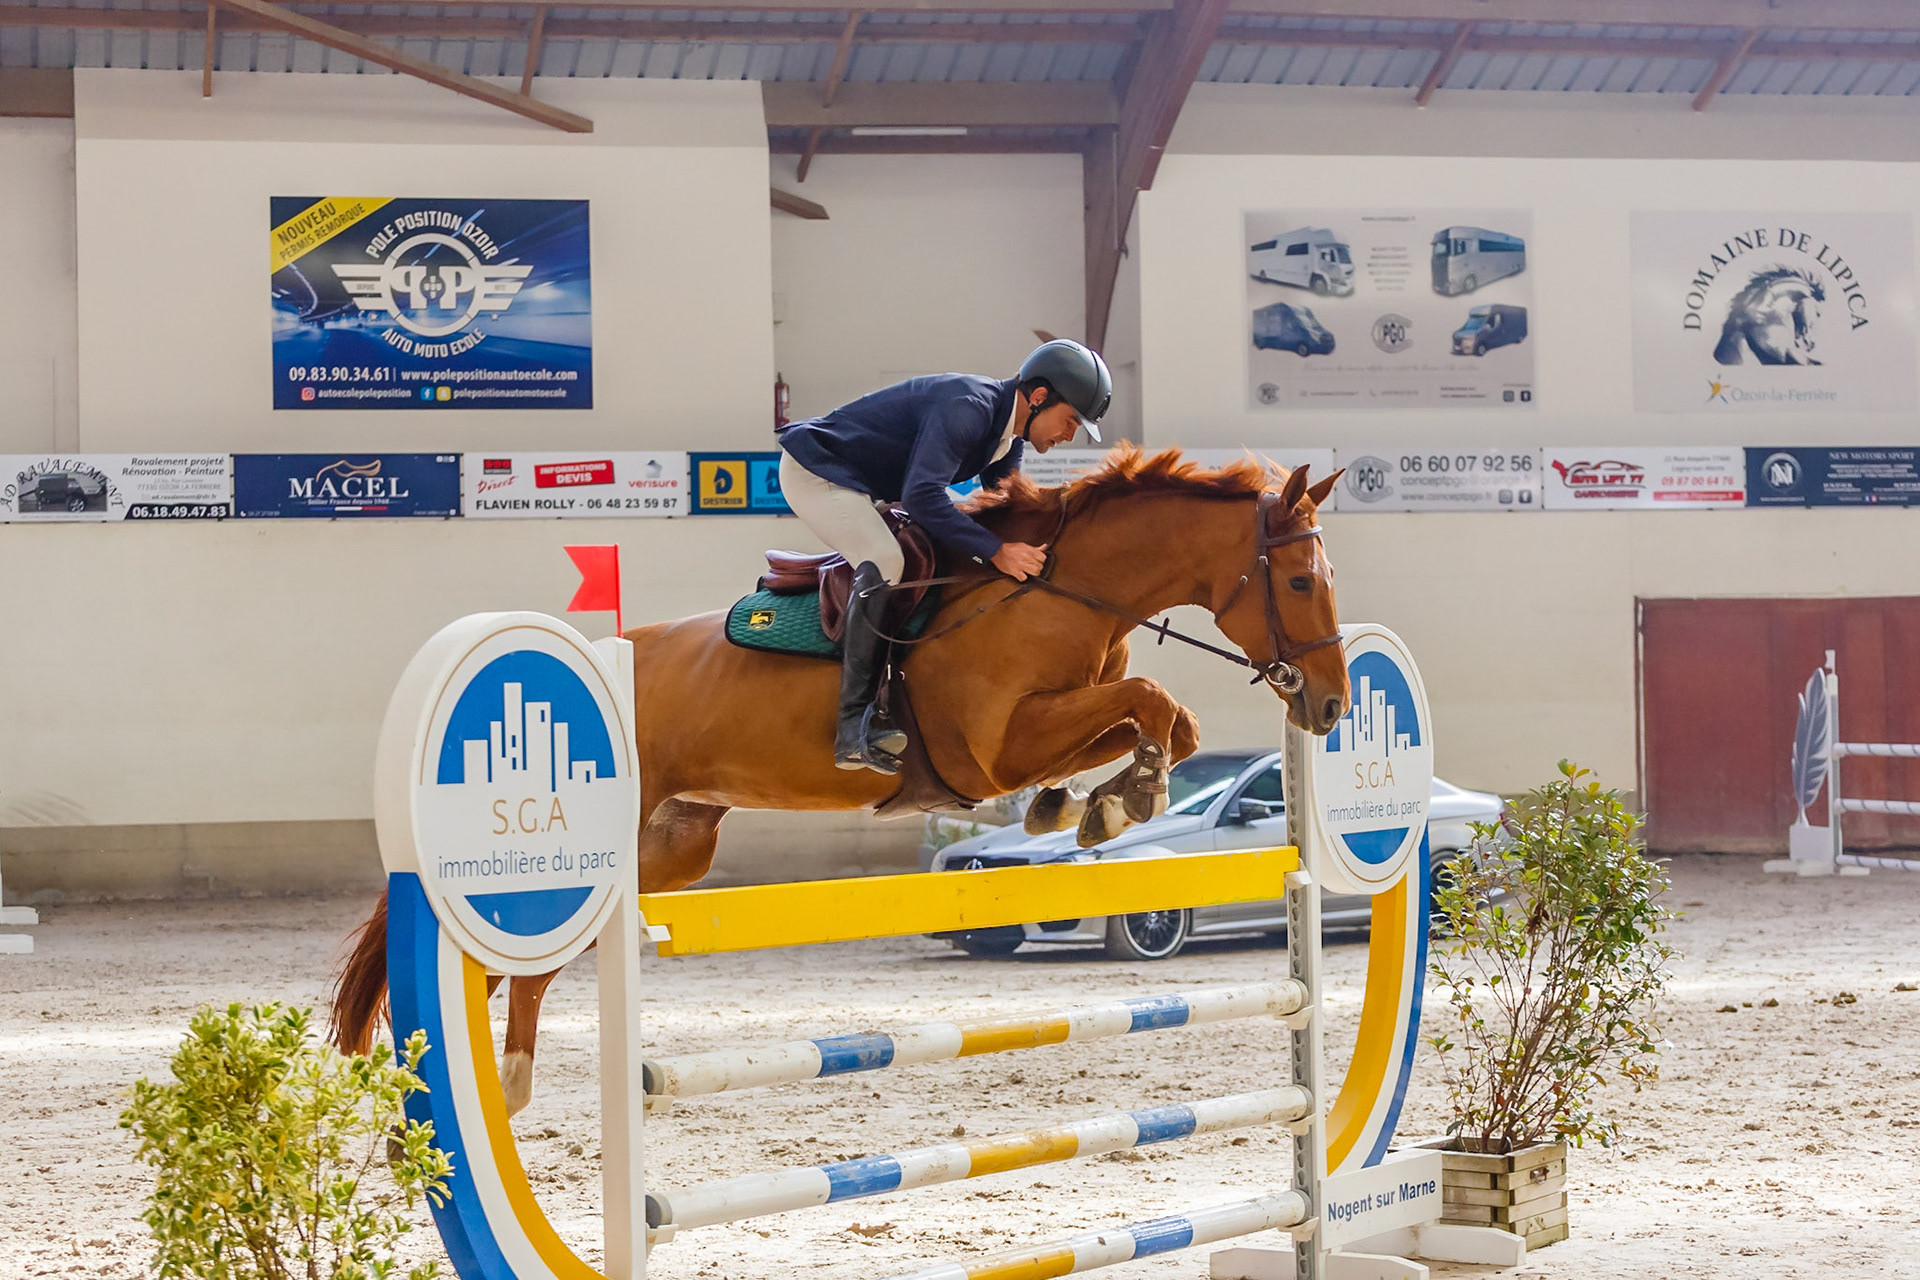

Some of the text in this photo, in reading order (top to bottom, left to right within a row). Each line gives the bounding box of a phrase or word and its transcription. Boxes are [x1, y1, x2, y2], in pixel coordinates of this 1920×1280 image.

[277, 202, 337, 245] NOUVEAU
[279, 202, 366, 261] PERMIS REMORQUE
[365, 210, 500, 260] POLE POSITION OZOIR
[1683, 227, 1869, 331] DOMAINE DE LIPICA
[380, 327, 487, 358] AUTO MOTO ECOLE
[288, 367, 578, 383] 09.83.90.34.61 www.polepositionautoecole.com
[1730, 388, 1837, 402] Ozoir-la-Ferrière
[122, 466, 175, 476] Rénovation
[184, 467, 225, 476] Peinture
[130, 457, 225, 469] Ravalement projeté
[540, 462, 607, 475] INFORMATIONS
[1399, 455, 1533, 472] 06 60 07 92 56
[1, 457, 126, 512] AD RAVALEMENT
[288, 476, 409, 498] MACEL
[556, 472, 593, 484] DEVIS
[628, 479, 678, 488] verisure
[1661, 476, 1673, 486] 09
[132, 505, 226, 518] 06.18.49.47.83
[475, 499, 530, 510] FLAVIEN
[534, 499, 575, 509] ROLLY
[587, 498, 602, 509] 06
[606, 498, 621, 509] 48
[625, 498, 640, 509] 23
[644, 498, 659, 508] 59
[663, 498, 678, 508] 87
[1354, 760, 1395, 790] S.G.A
[492, 797, 568, 835] S.G.A
[1327, 797, 1421, 822] immobilière du parc
[438, 846, 616, 879] immobilière du parc
[1327, 1179, 1436, 1222] Nogent sur Marne
